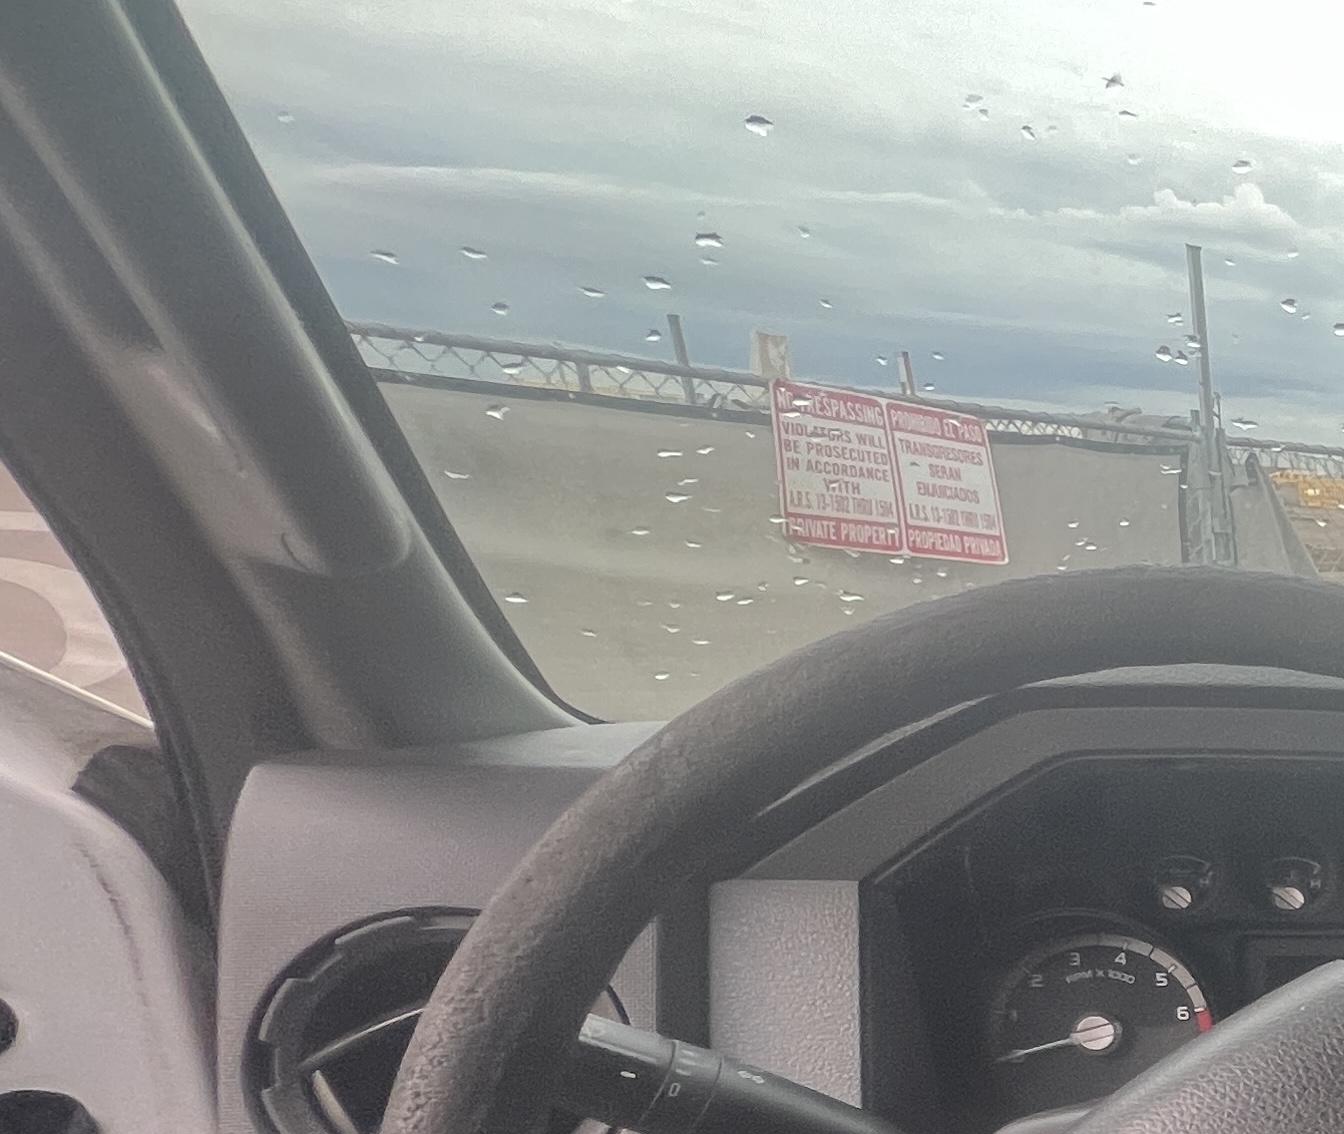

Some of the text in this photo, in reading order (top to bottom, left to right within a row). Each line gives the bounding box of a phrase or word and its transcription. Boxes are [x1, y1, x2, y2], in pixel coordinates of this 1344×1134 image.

[776, 388, 795, 410] NO
[855, 432, 887, 450] WILL
[783, 438, 889, 466] BE PROSECUTED
[786, 456, 891, 483] IN ACCORDANCE
[788, 516, 901, 548] PRIVATE PROPERTY
[1069, 952, 1081, 967] 3
[1114, 951, 1127, 966] 4
[1155, 972, 1169, 988] 5
[1176, 1006, 1190, 1021] 6
